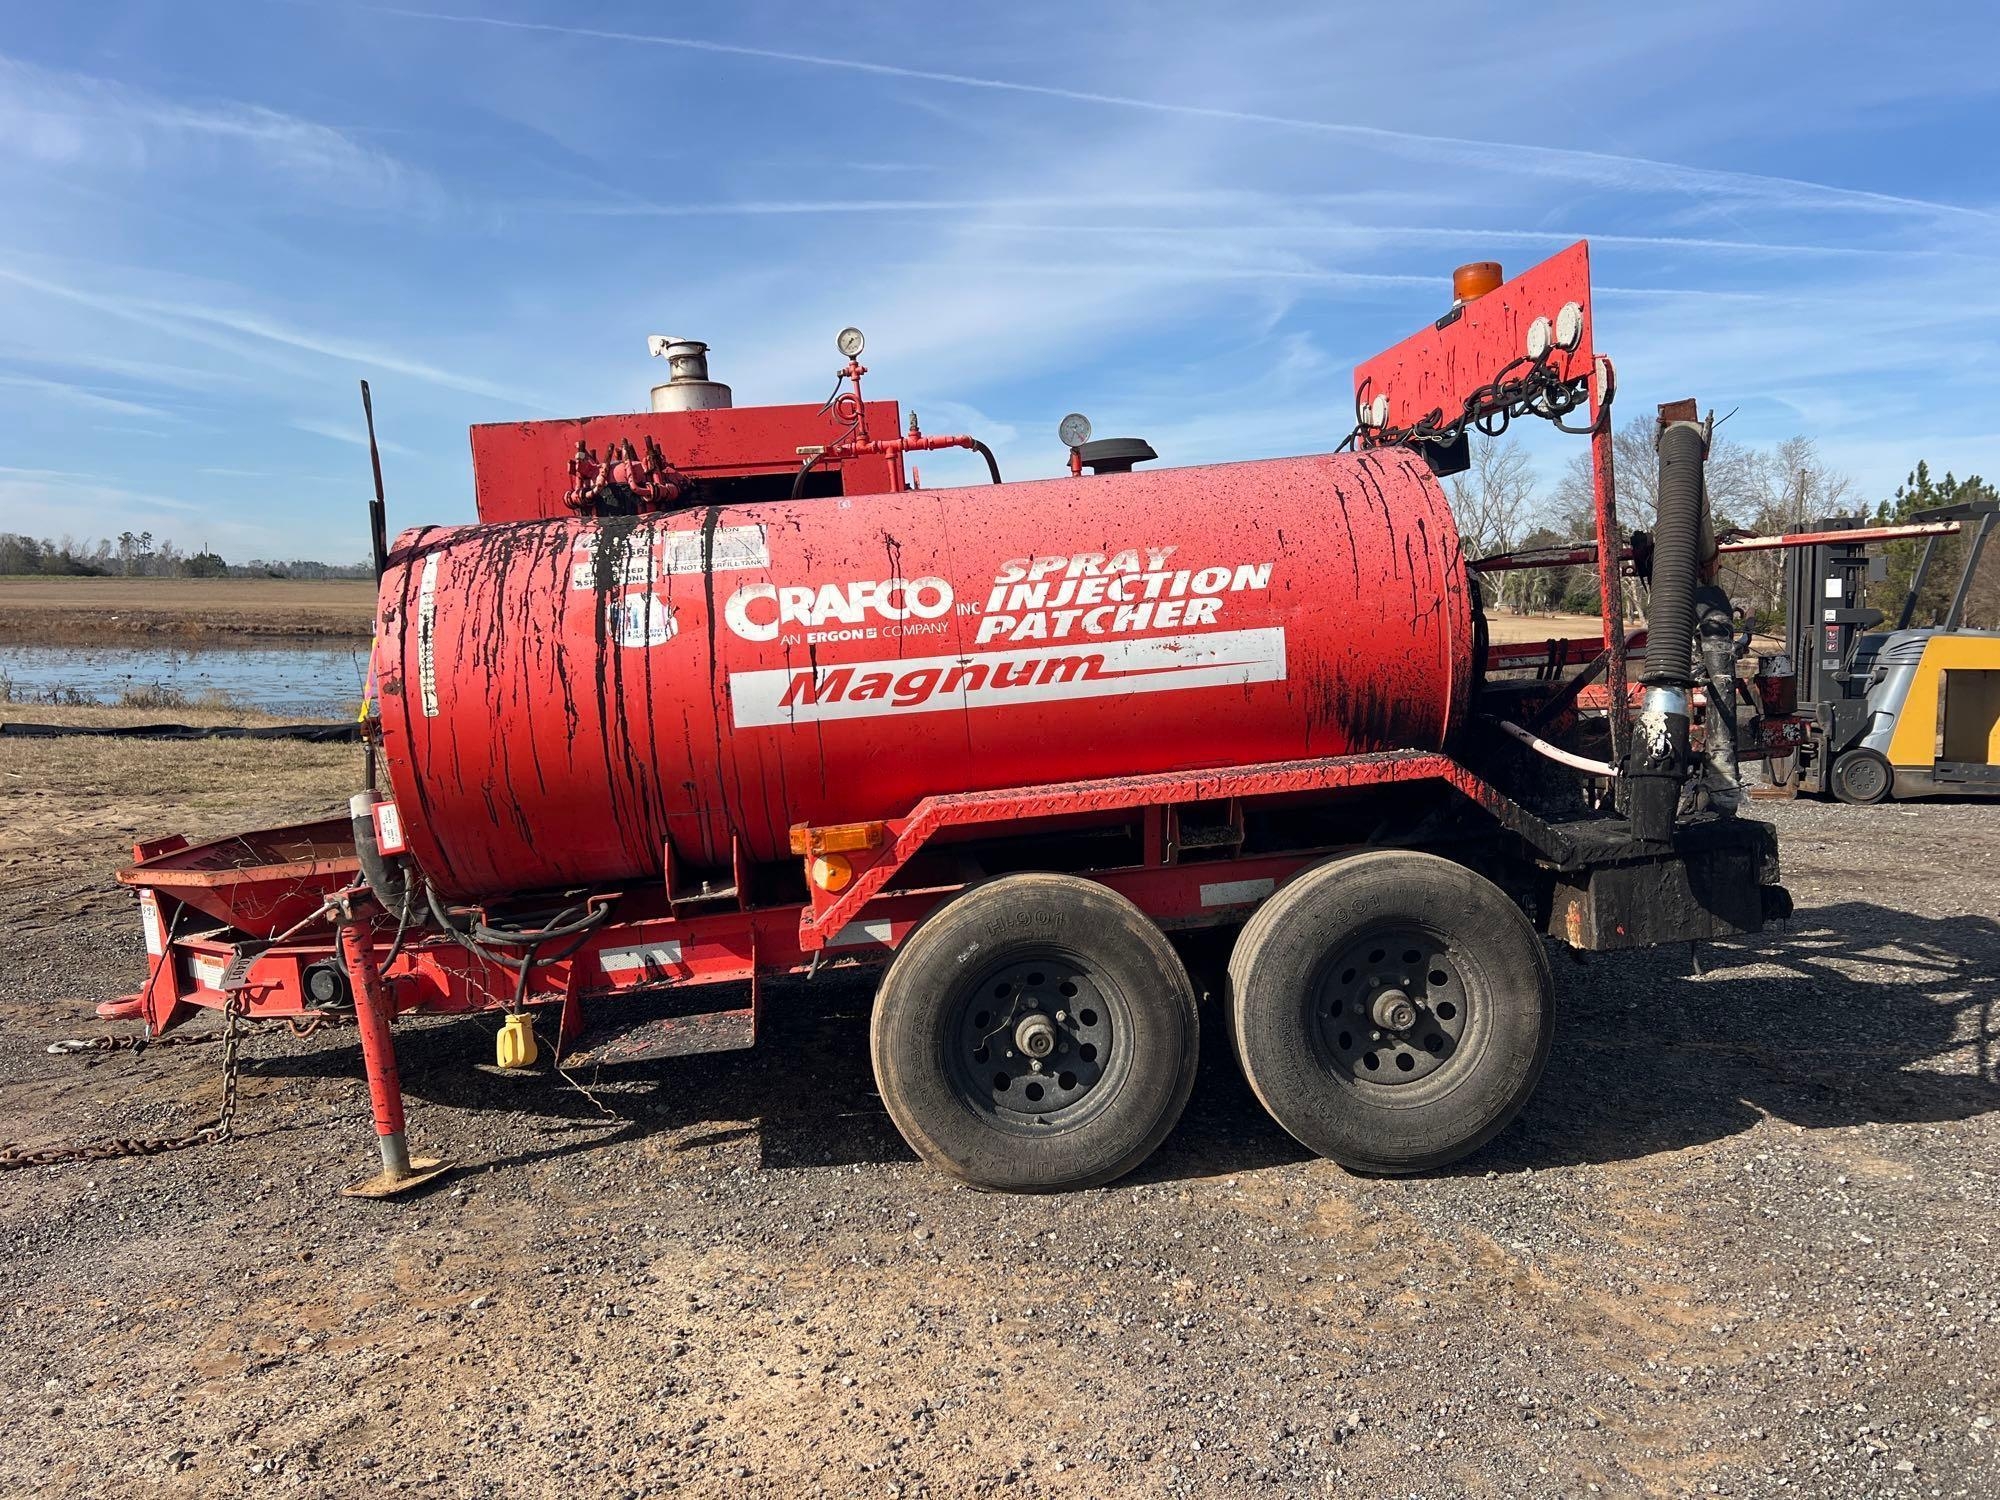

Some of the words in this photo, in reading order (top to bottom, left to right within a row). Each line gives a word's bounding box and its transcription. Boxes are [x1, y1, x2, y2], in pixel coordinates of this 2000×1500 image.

[985, 562, 1274, 613] INJECTION
[994, 545, 1179, 584] SPRAY
[724, 576, 955, 642] CRAFCO
[956, 600, 980, 617] INC
[974, 597, 1223, 645] PATCHER
[780, 633, 800, 646] AN
[807, 629, 864, 644] ERGON
[883, 621, 949, 638] COMPANY
[777, 653, 1106, 707] Magnum
[984, 910, 1066, 937] H-901
